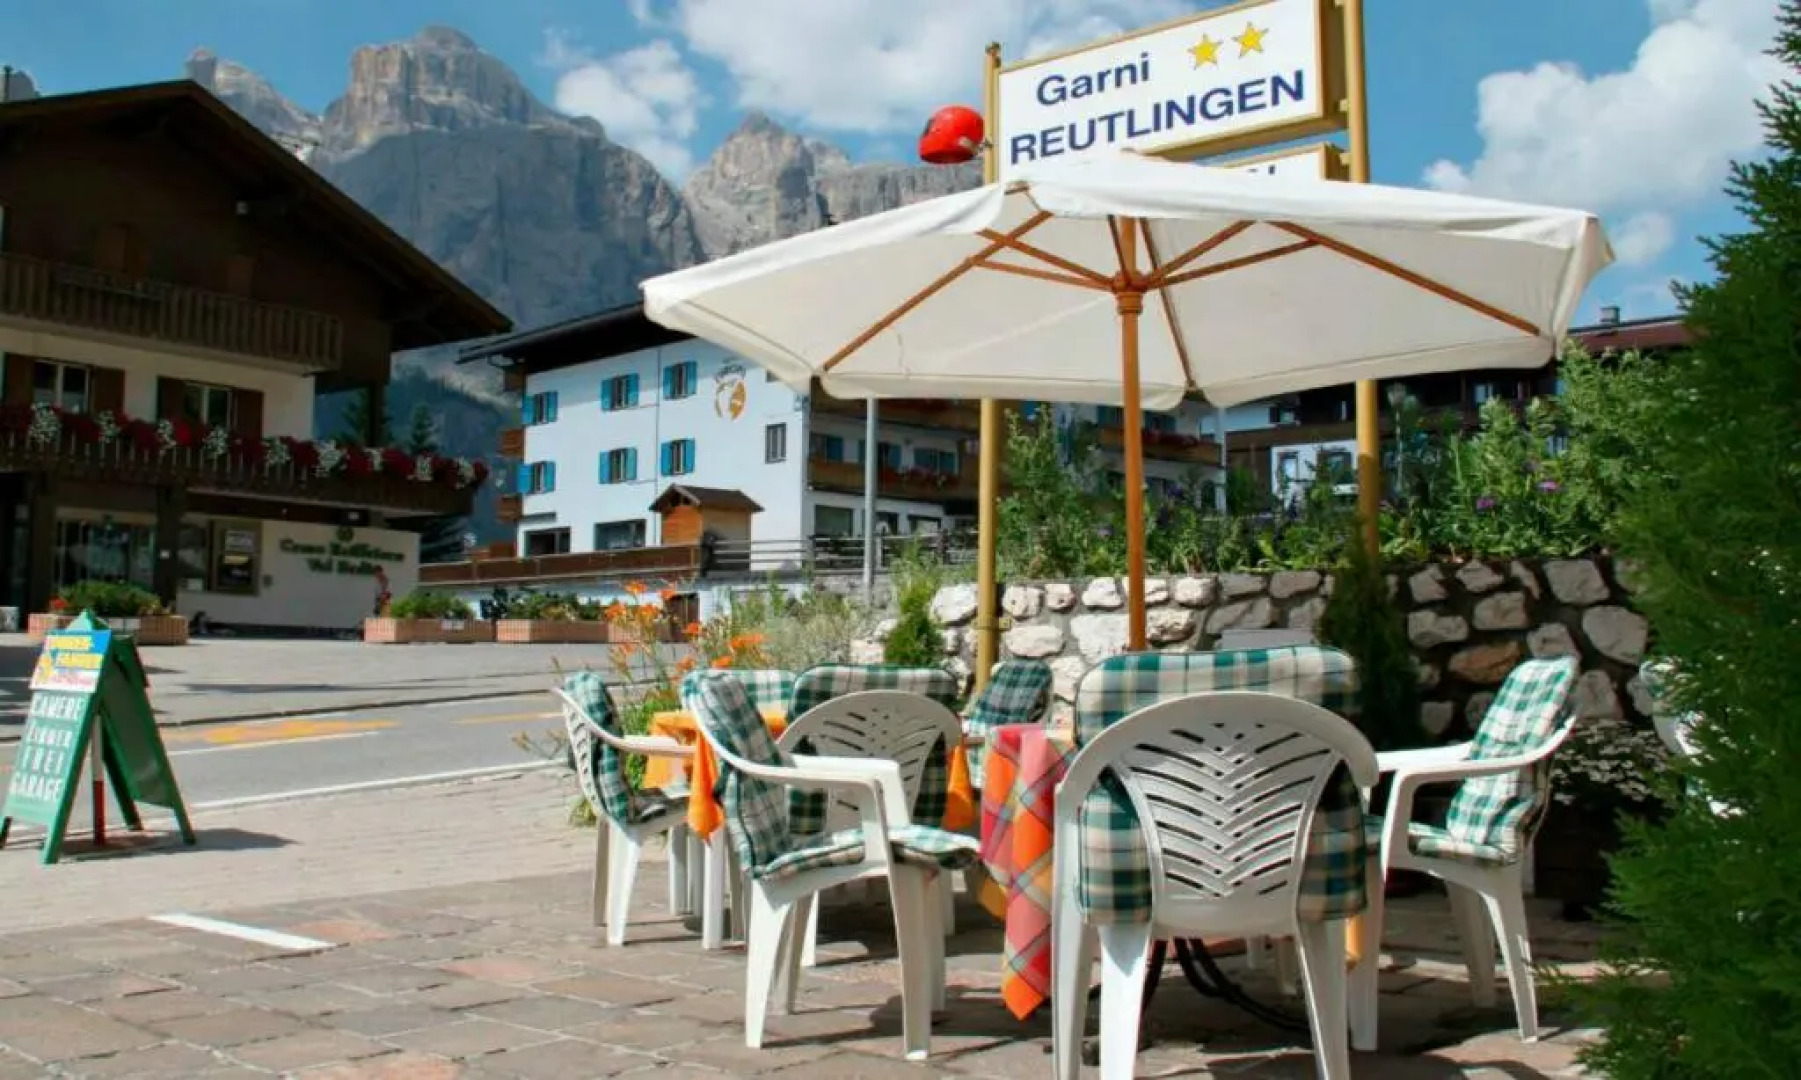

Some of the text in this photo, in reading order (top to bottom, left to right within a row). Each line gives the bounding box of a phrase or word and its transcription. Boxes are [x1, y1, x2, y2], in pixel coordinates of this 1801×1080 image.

[1037, 52, 1150, 106] Garni
[1010, 70, 1304, 165] REUTLINGEN
[31, 693, 86, 721] CAMERE
[21, 745, 65, 774] FREI
[8, 770, 66, 802] GARAGE
